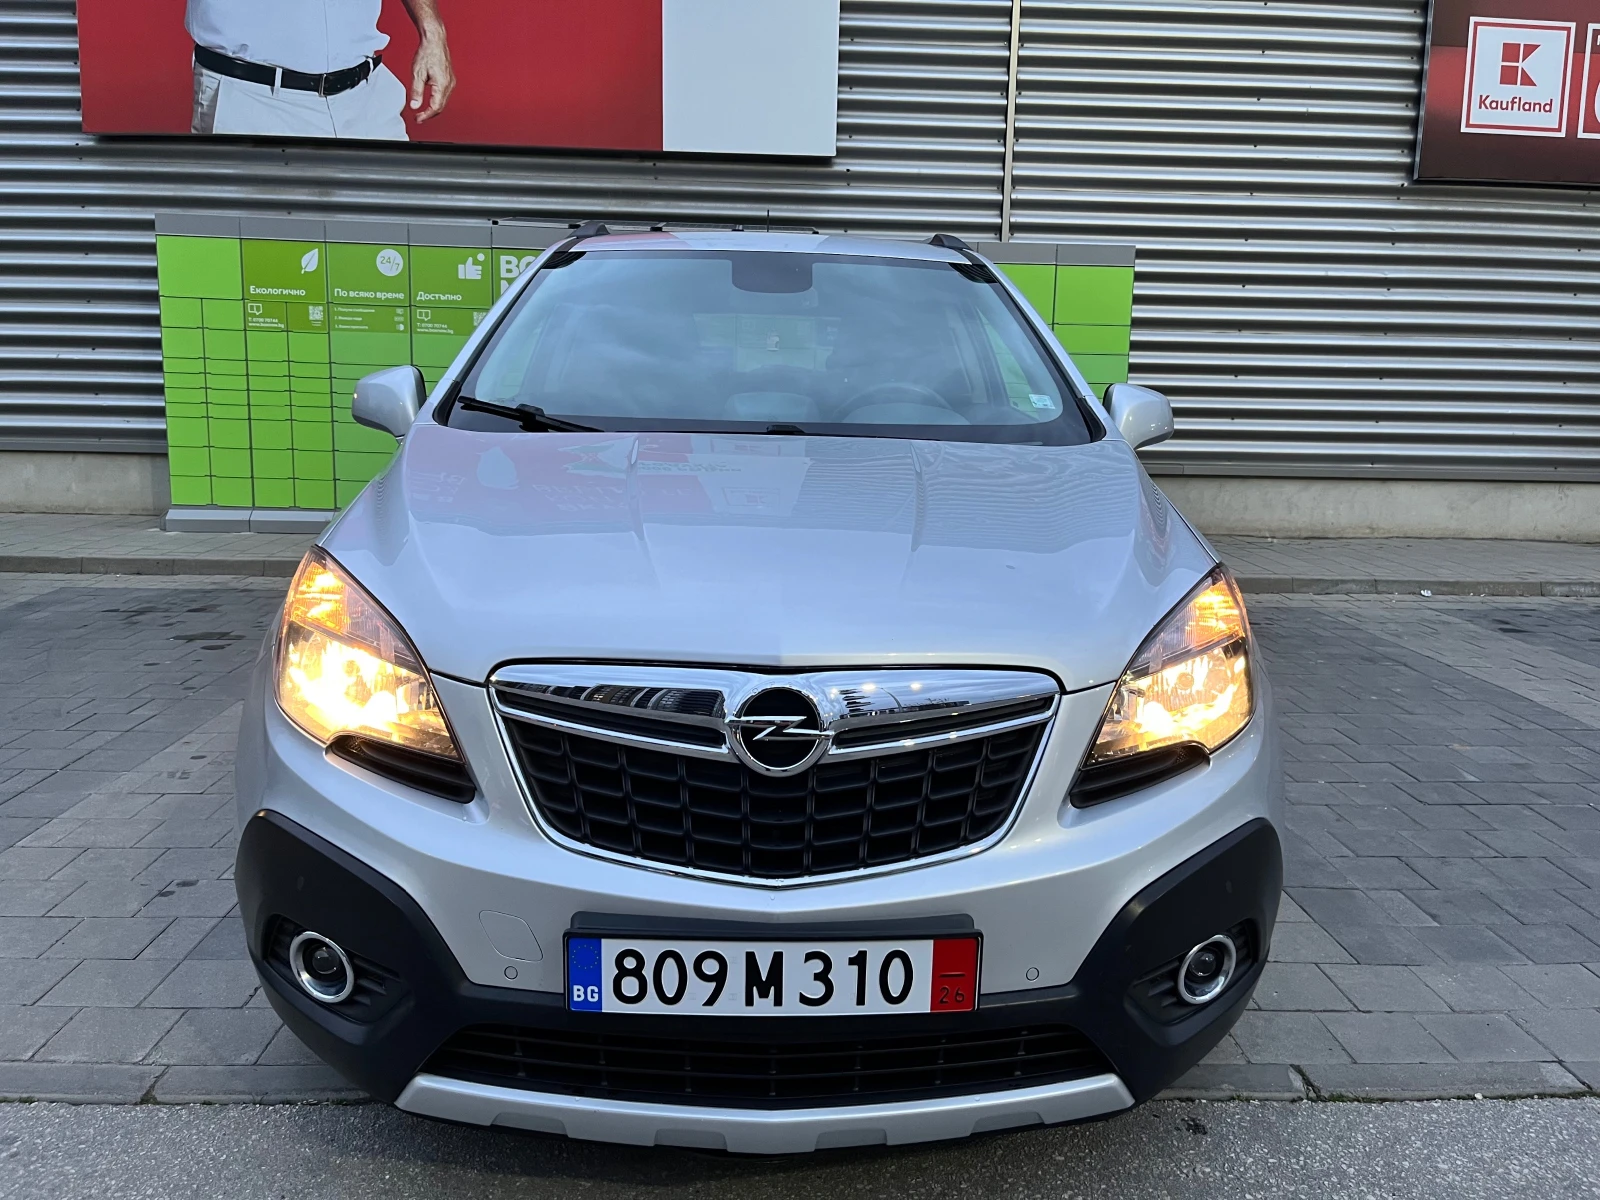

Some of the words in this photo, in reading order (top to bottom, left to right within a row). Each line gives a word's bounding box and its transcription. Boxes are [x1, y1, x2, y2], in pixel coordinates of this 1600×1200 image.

[1478, 94, 1553, 113] Kaufland
[380, 255, 401, 272] 24/7
[249, 285, 306, 296] Екологично
[334, 288, 348, 297] По
[349, 290, 375, 298] всяко
[376, 292, 405, 300] време
[416, 291, 462, 301] Достъпно
[612, 948, 728, 1007] 809
[745, 950, 784, 1007] M
[798, 949, 914, 1007] 310
[573, 984, 599, 1002] BG
[938, 985, 966, 1005] 26
